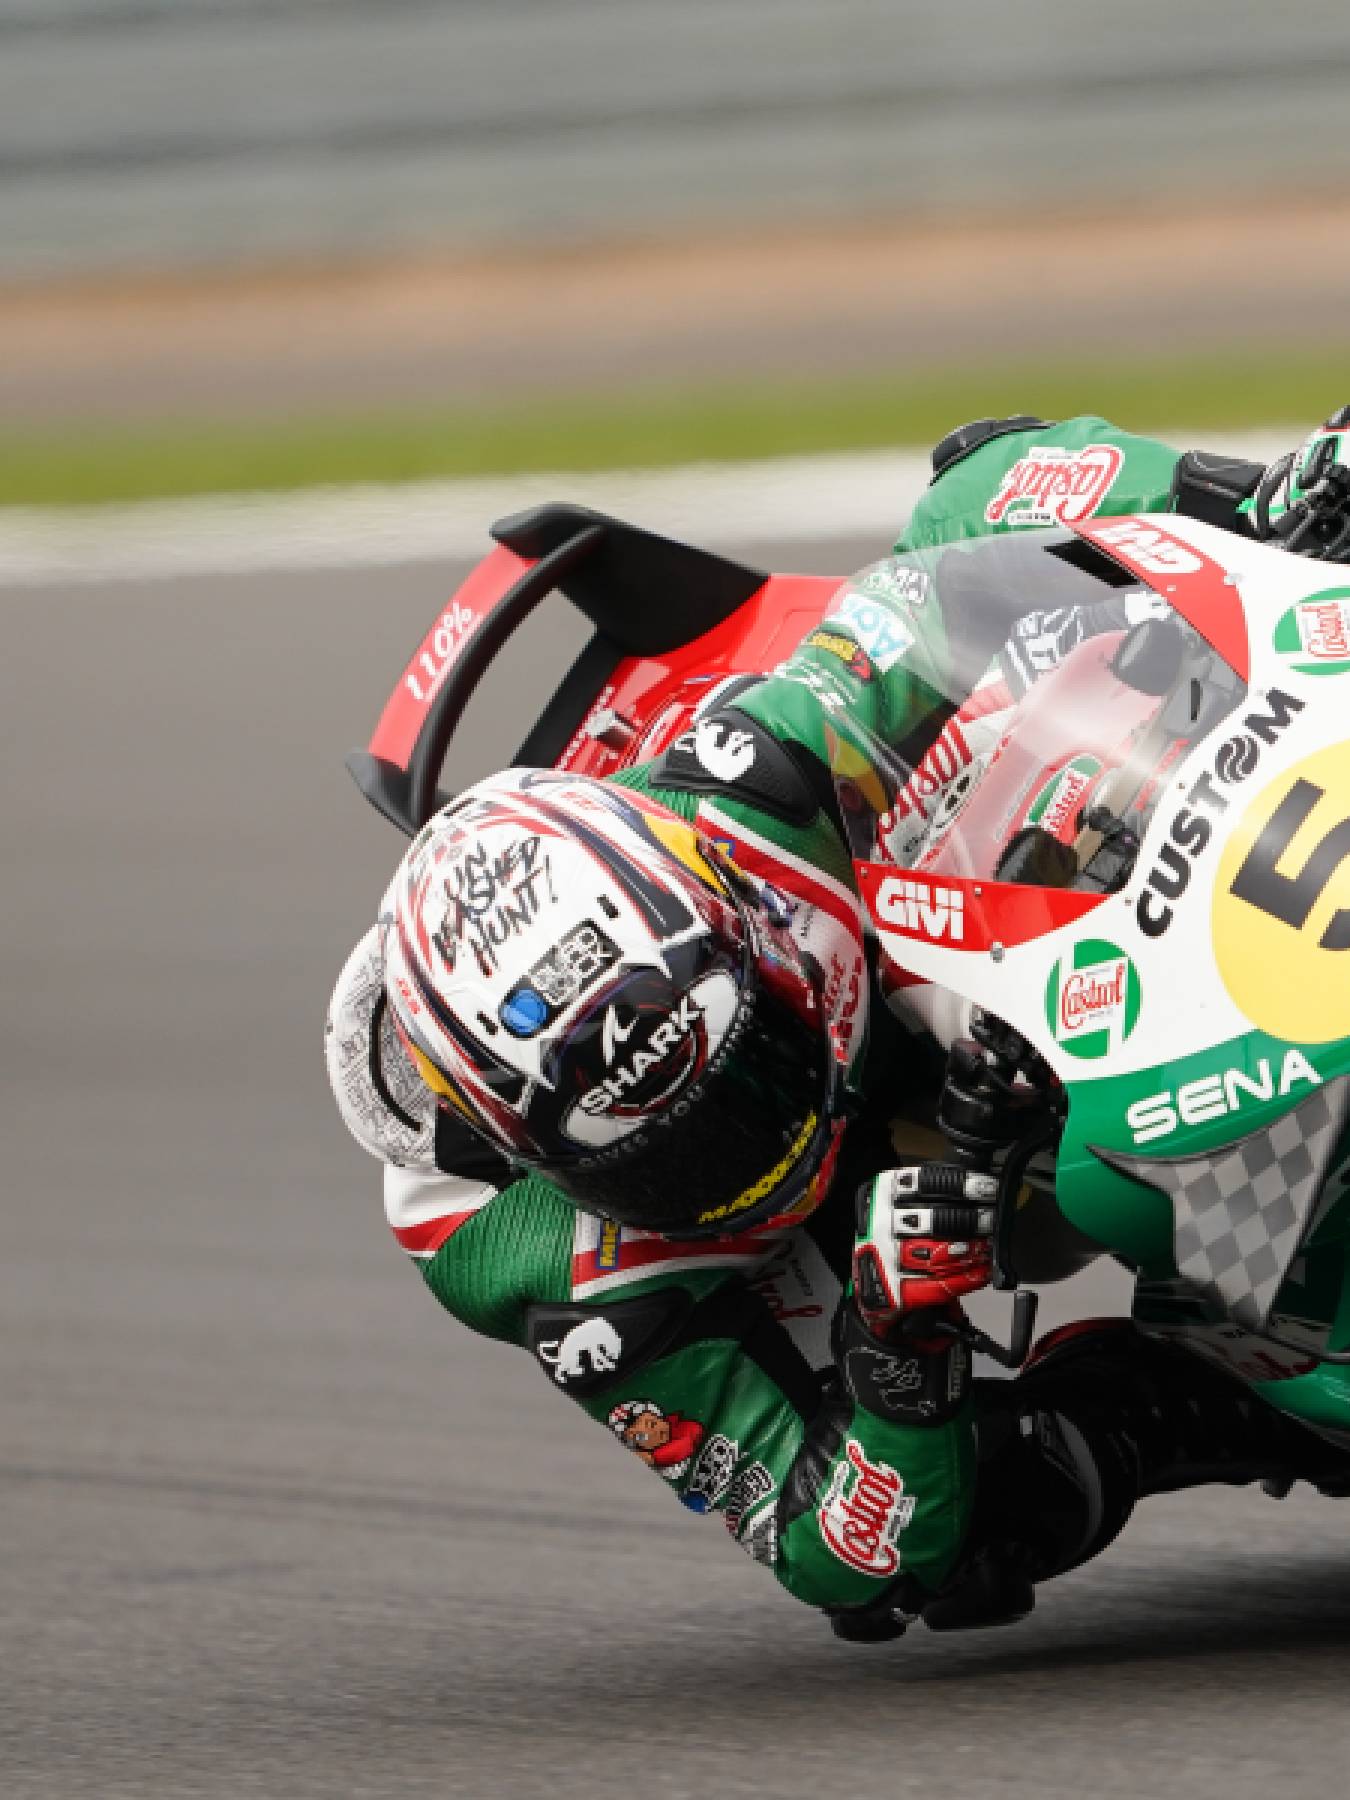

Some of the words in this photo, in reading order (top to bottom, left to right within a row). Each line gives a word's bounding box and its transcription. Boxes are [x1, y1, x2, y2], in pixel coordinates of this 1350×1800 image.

[405, 601, 475, 701] 110%
[1136, 686, 1306, 938] CUSTOM
[876, 876, 964, 940] GIVI
[1063, 963, 1125, 1030] Castrol
[579, 997, 707, 1117] SHARK
[1126, 1049, 1323, 1144] SENA
[820, 1440, 900, 1578] Castrol
